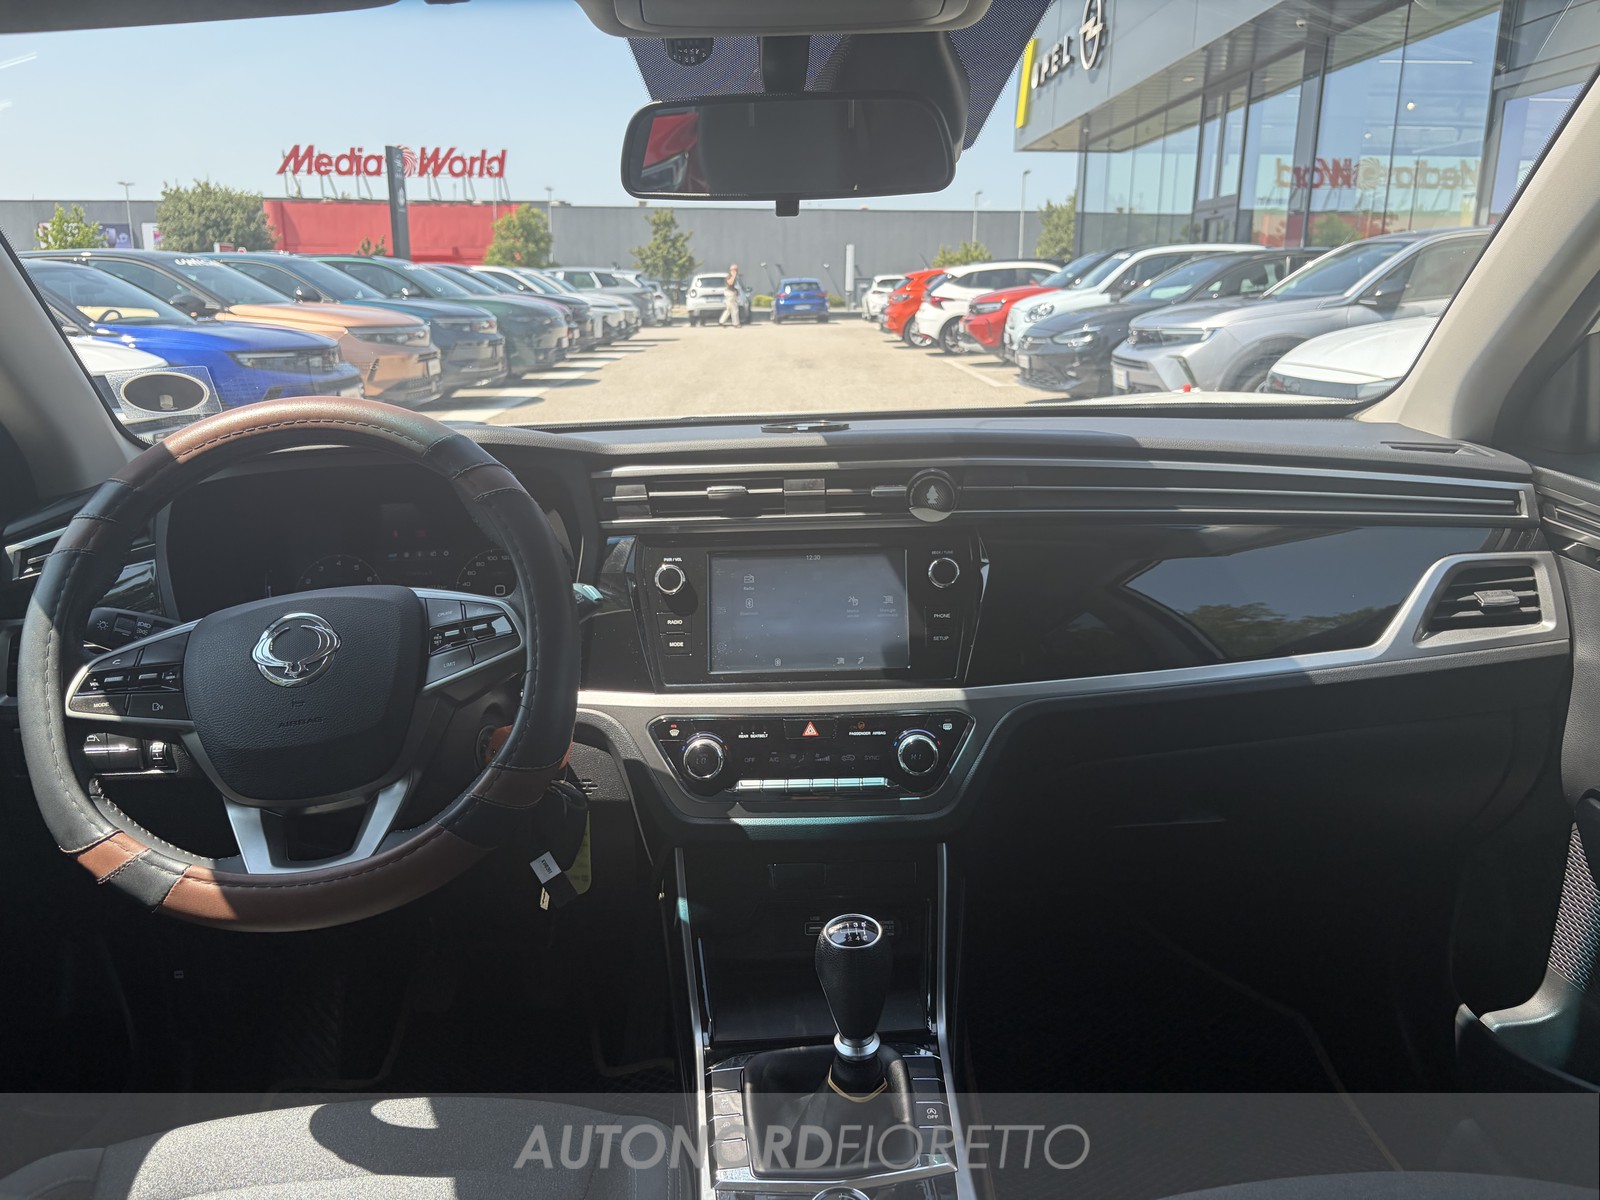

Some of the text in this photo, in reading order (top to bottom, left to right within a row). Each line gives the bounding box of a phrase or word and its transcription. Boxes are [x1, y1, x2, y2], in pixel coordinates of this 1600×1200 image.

[1030, 35, 1071, 90] OPEL
[276, 144, 383, 176] Media
[418, 147, 508, 178] World
[278, 716, 323, 728] AIRBAG
